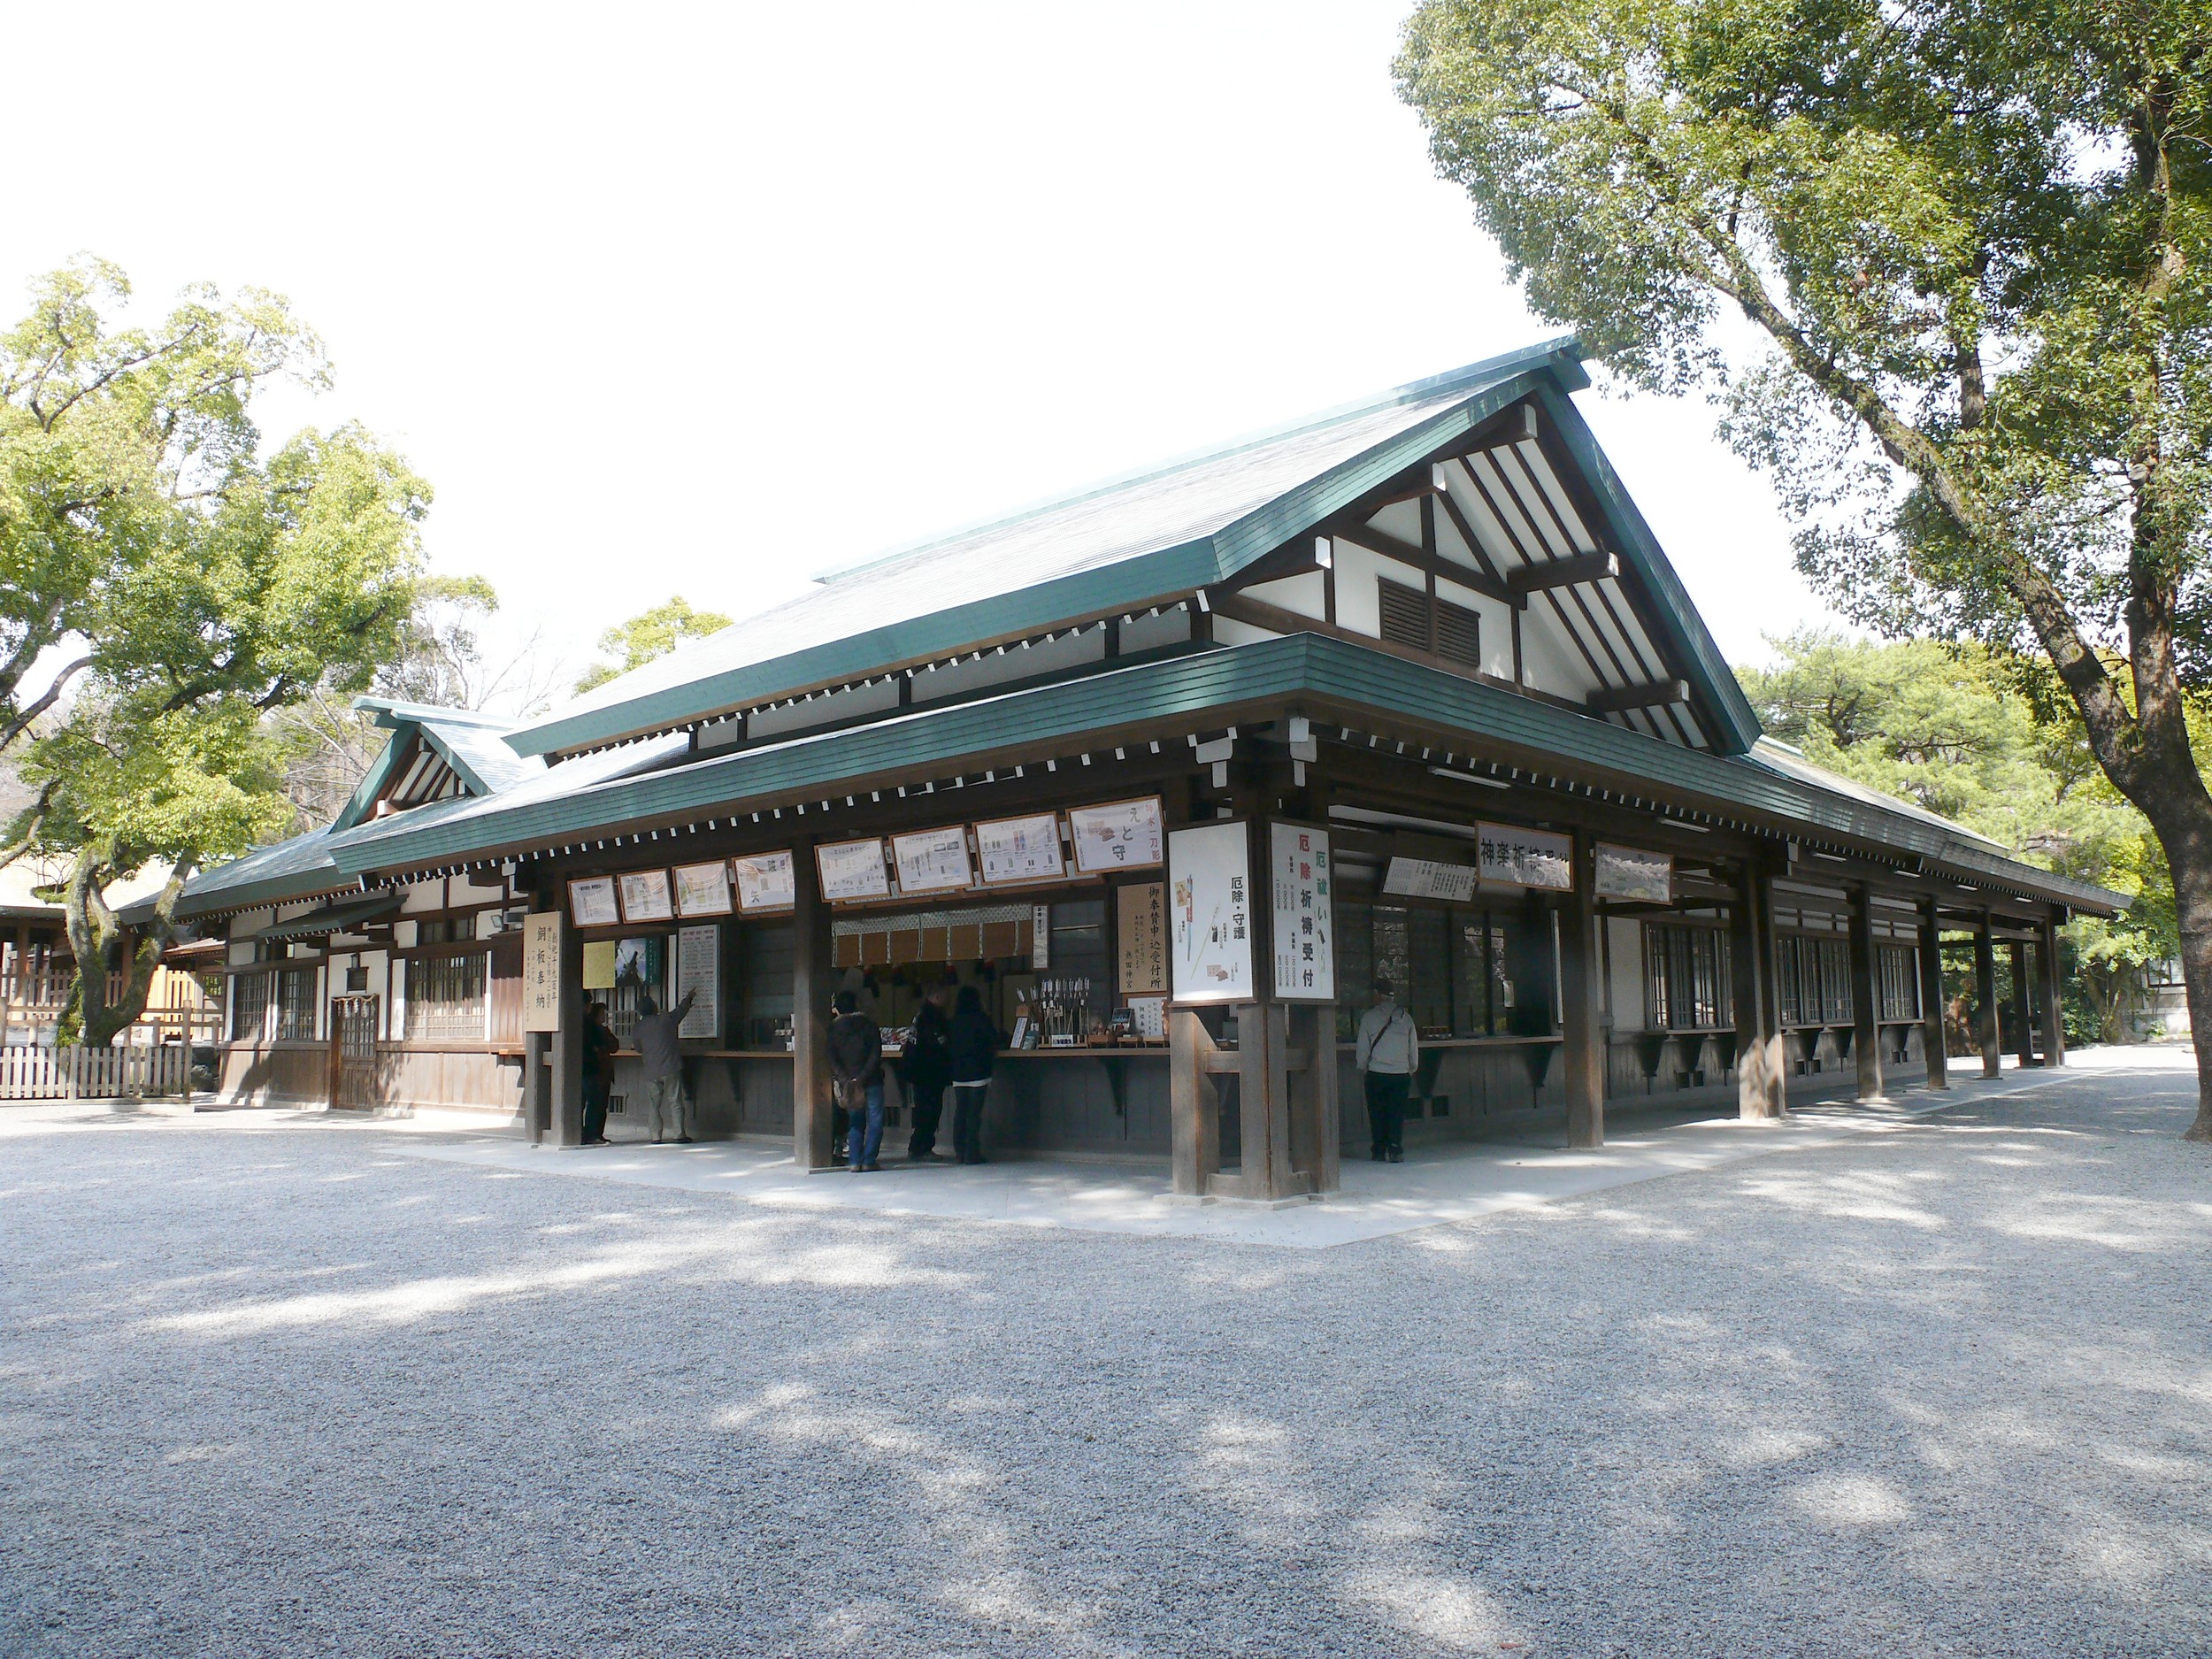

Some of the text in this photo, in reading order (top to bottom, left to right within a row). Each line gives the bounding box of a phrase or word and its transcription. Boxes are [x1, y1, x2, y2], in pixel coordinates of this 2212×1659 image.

[1112, 807, 1141, 861] えと守
[1231, 876, 1246, 940] 厄除・守護
[536, 926, 546, 1009] 銅板奉納
